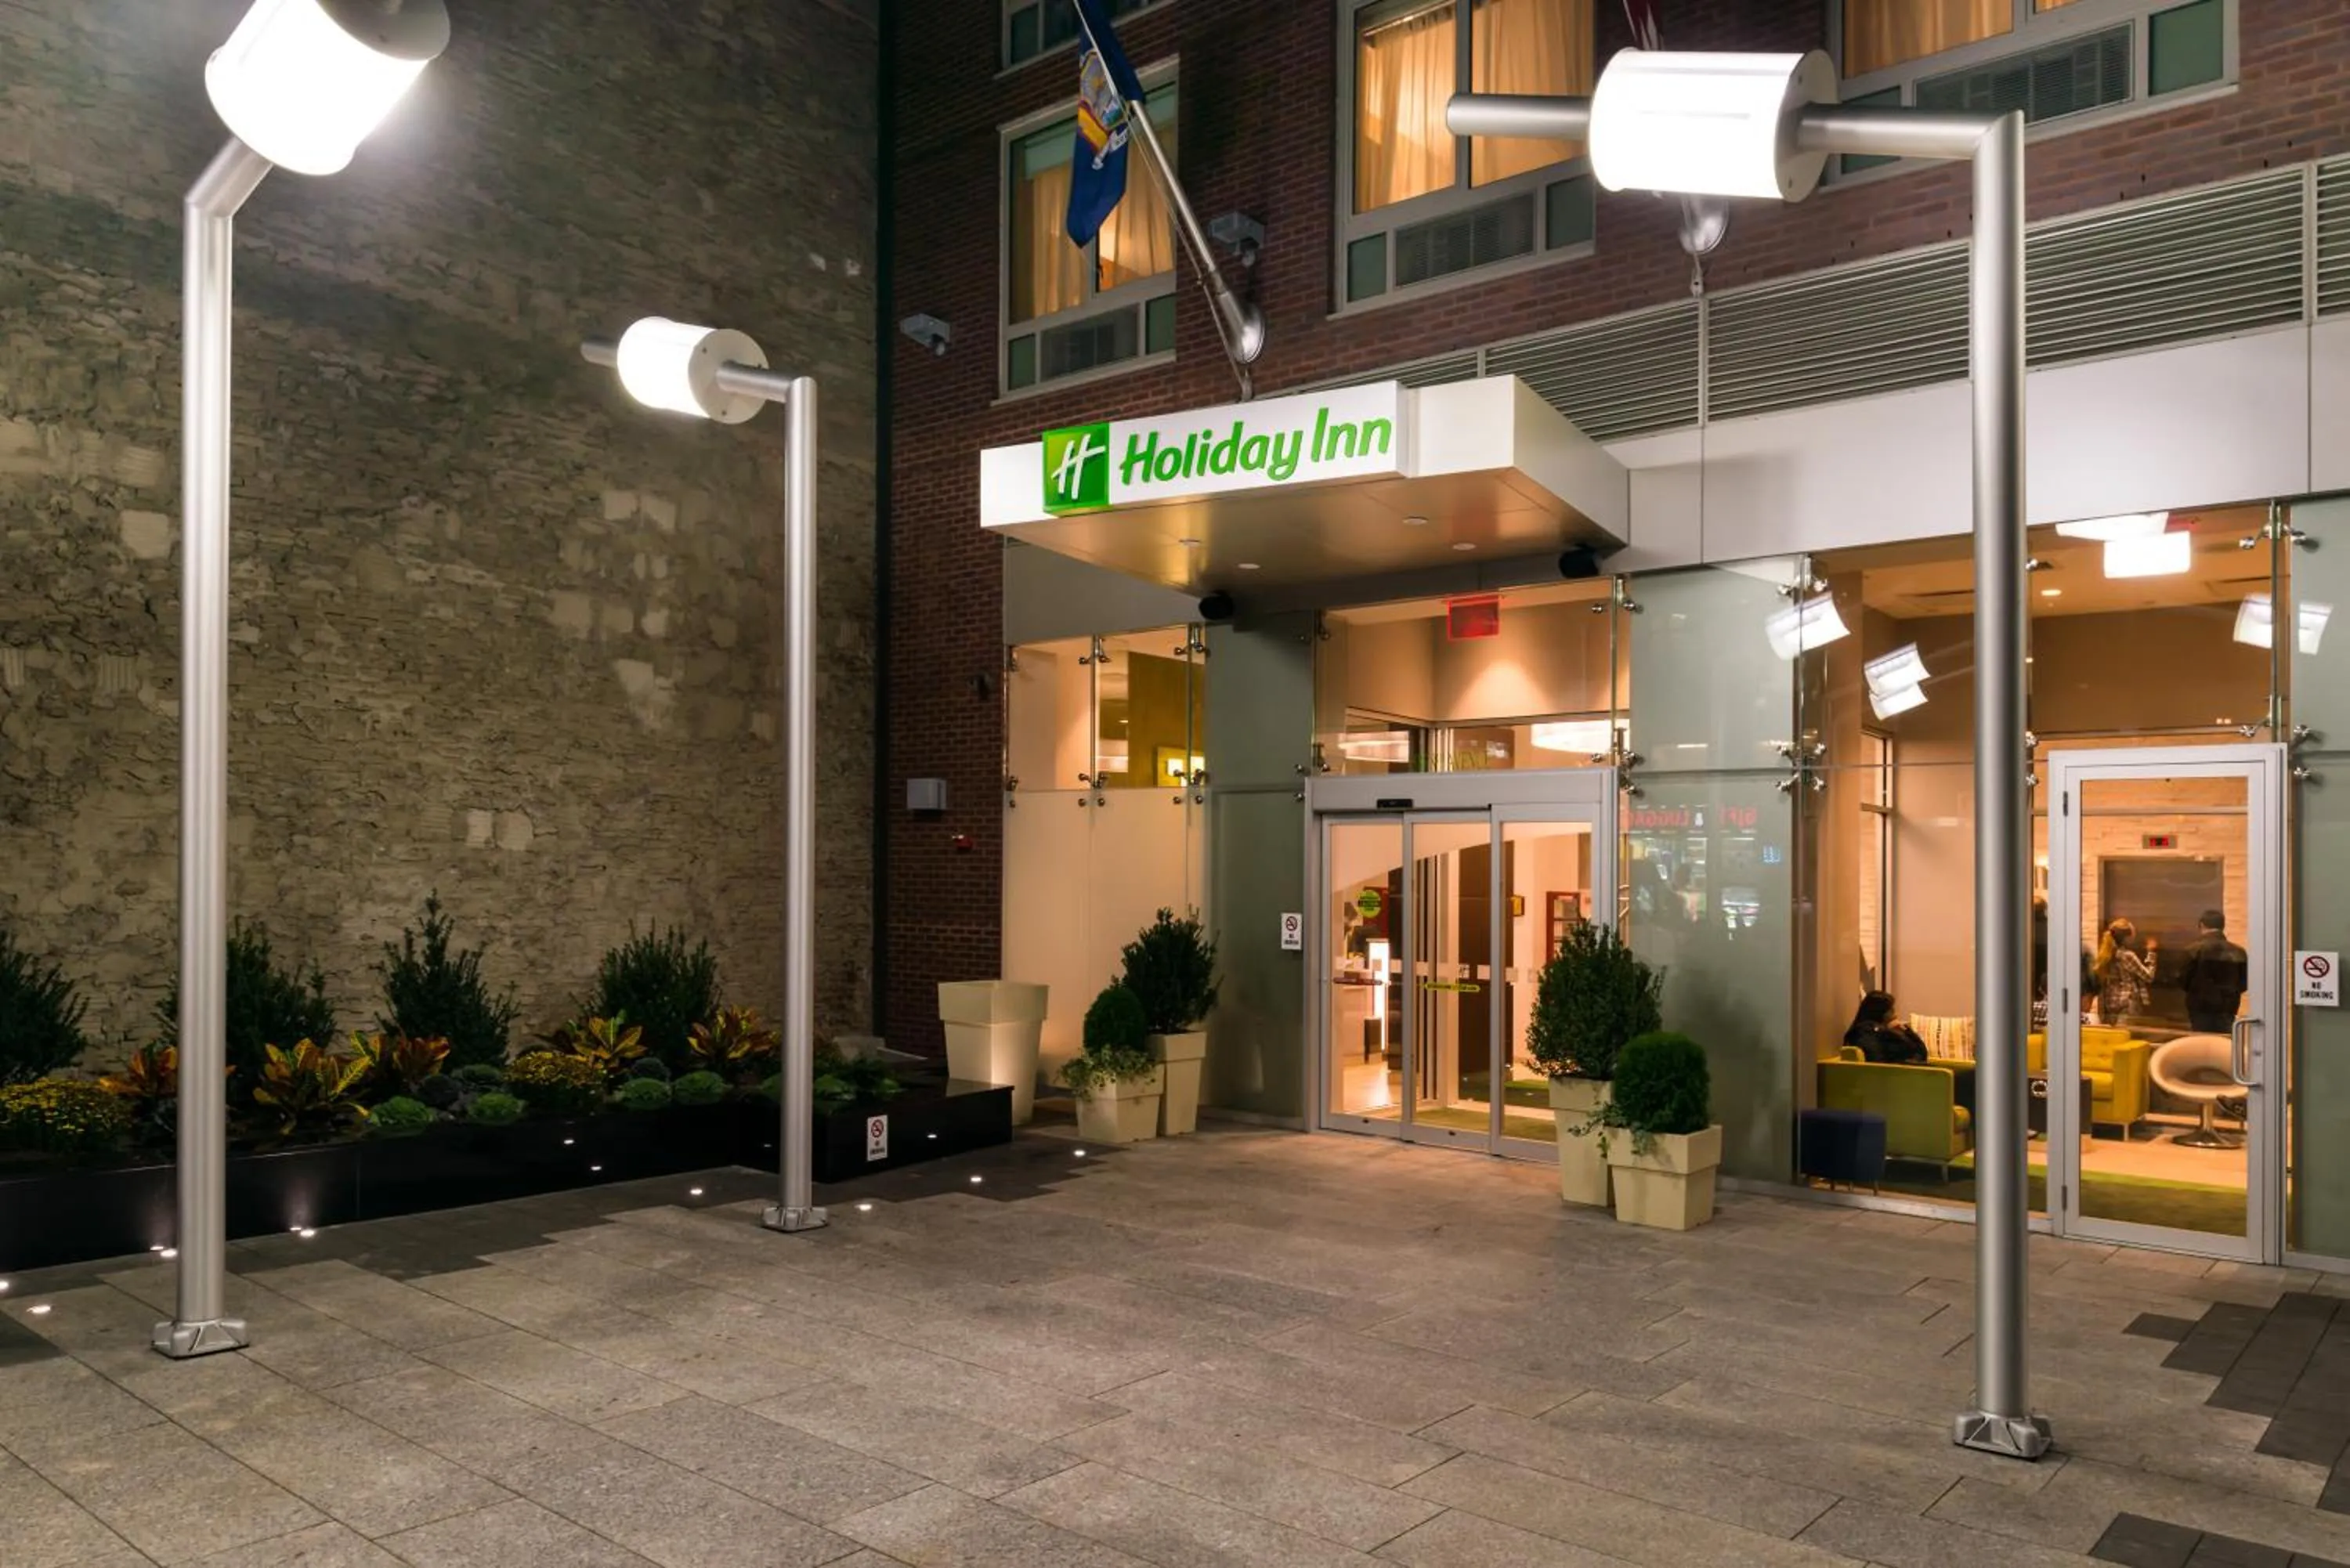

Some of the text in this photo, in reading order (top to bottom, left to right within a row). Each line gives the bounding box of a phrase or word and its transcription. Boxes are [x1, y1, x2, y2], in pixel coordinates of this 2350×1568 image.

[1119, 421, 1303, 485] Holiday
[1311, 407, 1391, 462] Inn
[2312, 981, 2321, 990] NO
[2300, 989, 2334, 999] SMOKING
